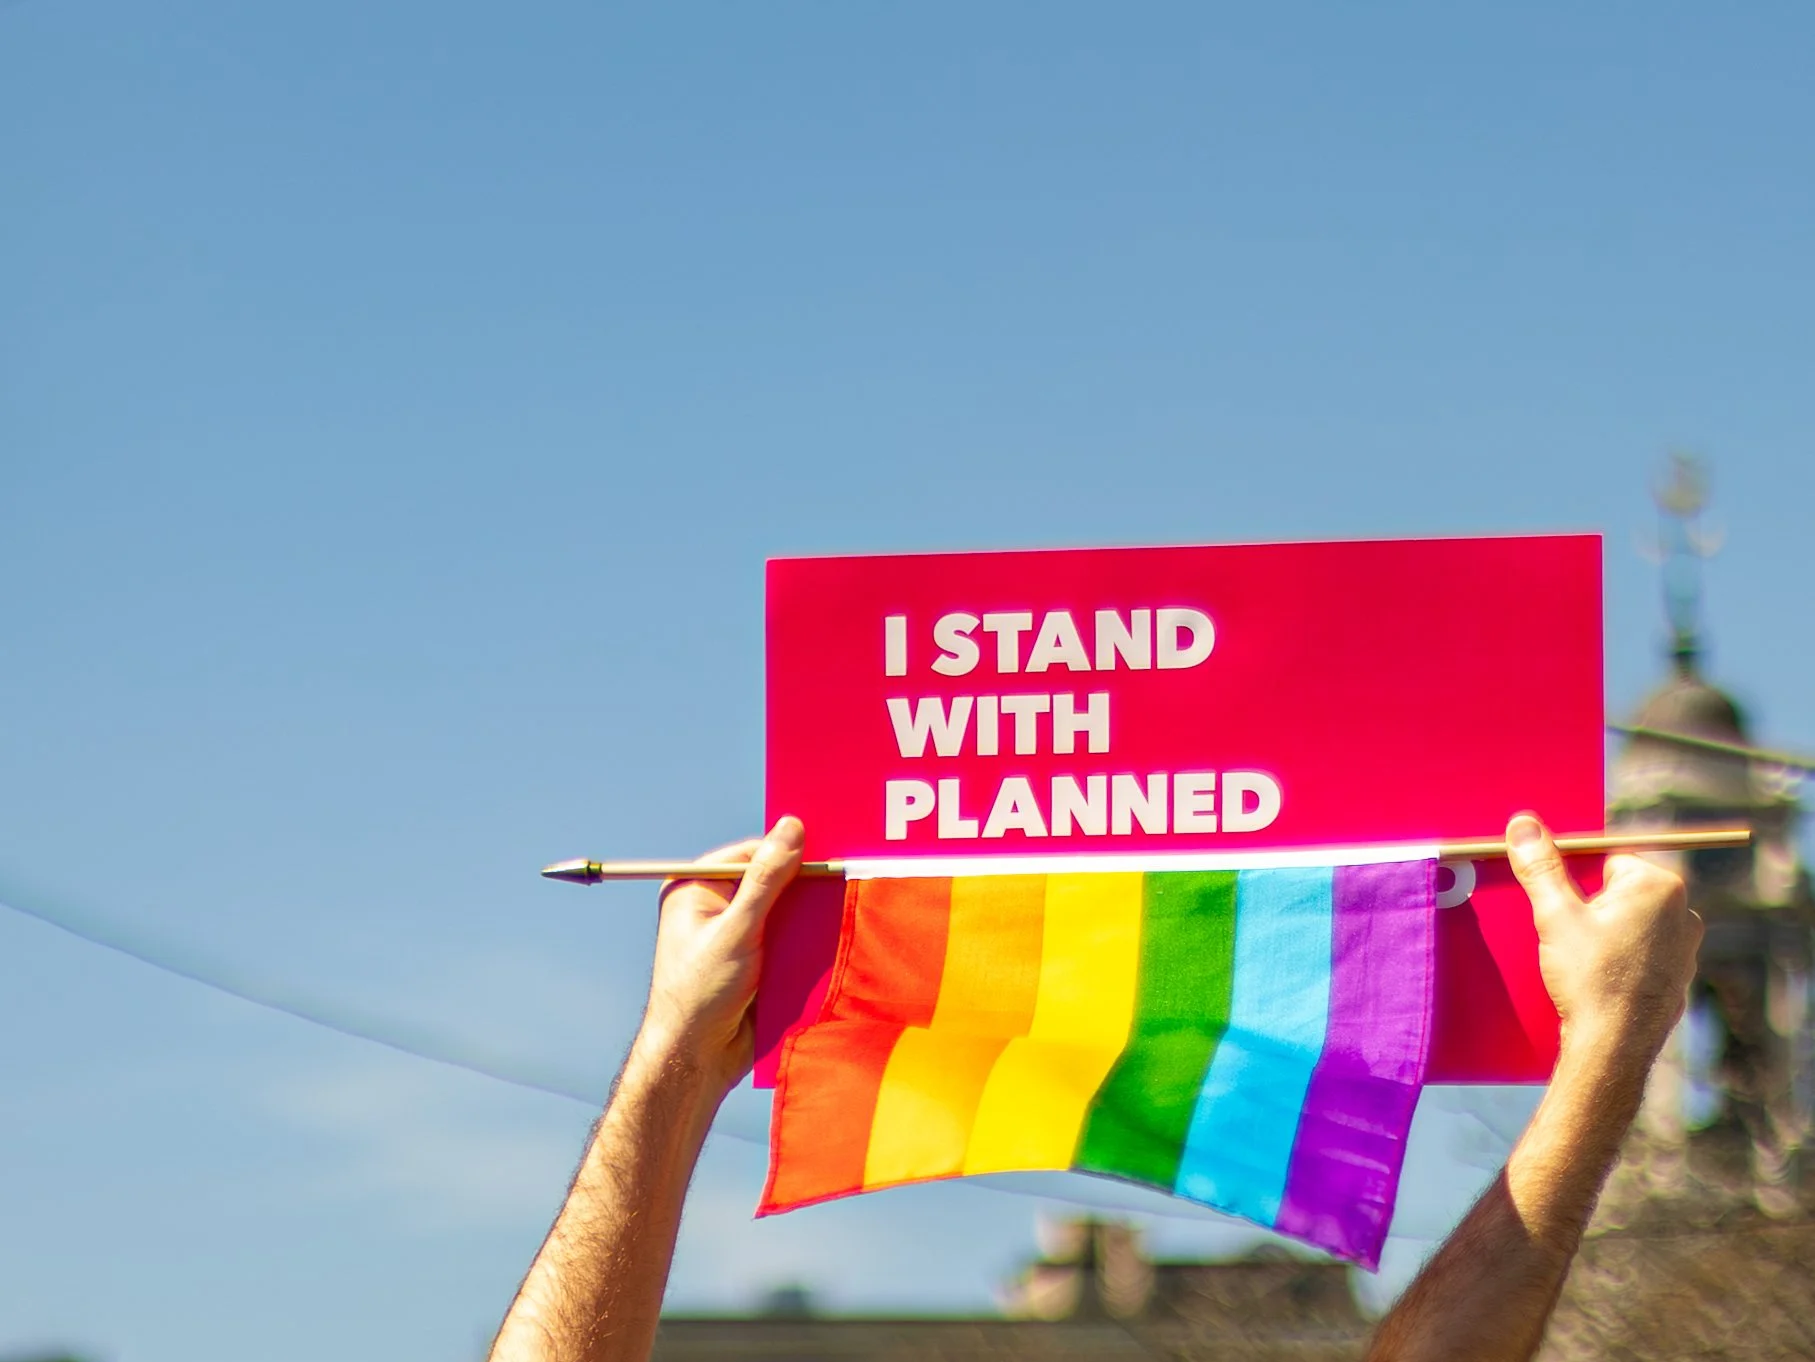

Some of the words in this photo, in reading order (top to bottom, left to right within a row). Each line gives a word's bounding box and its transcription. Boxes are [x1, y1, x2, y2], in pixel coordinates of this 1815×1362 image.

[885, 615, 907, 677] I
[930, 607, 1216, 677] STAND
[885, 692, 1110, 758] WITH
[885, 771, 1282, 841] PLANNED
